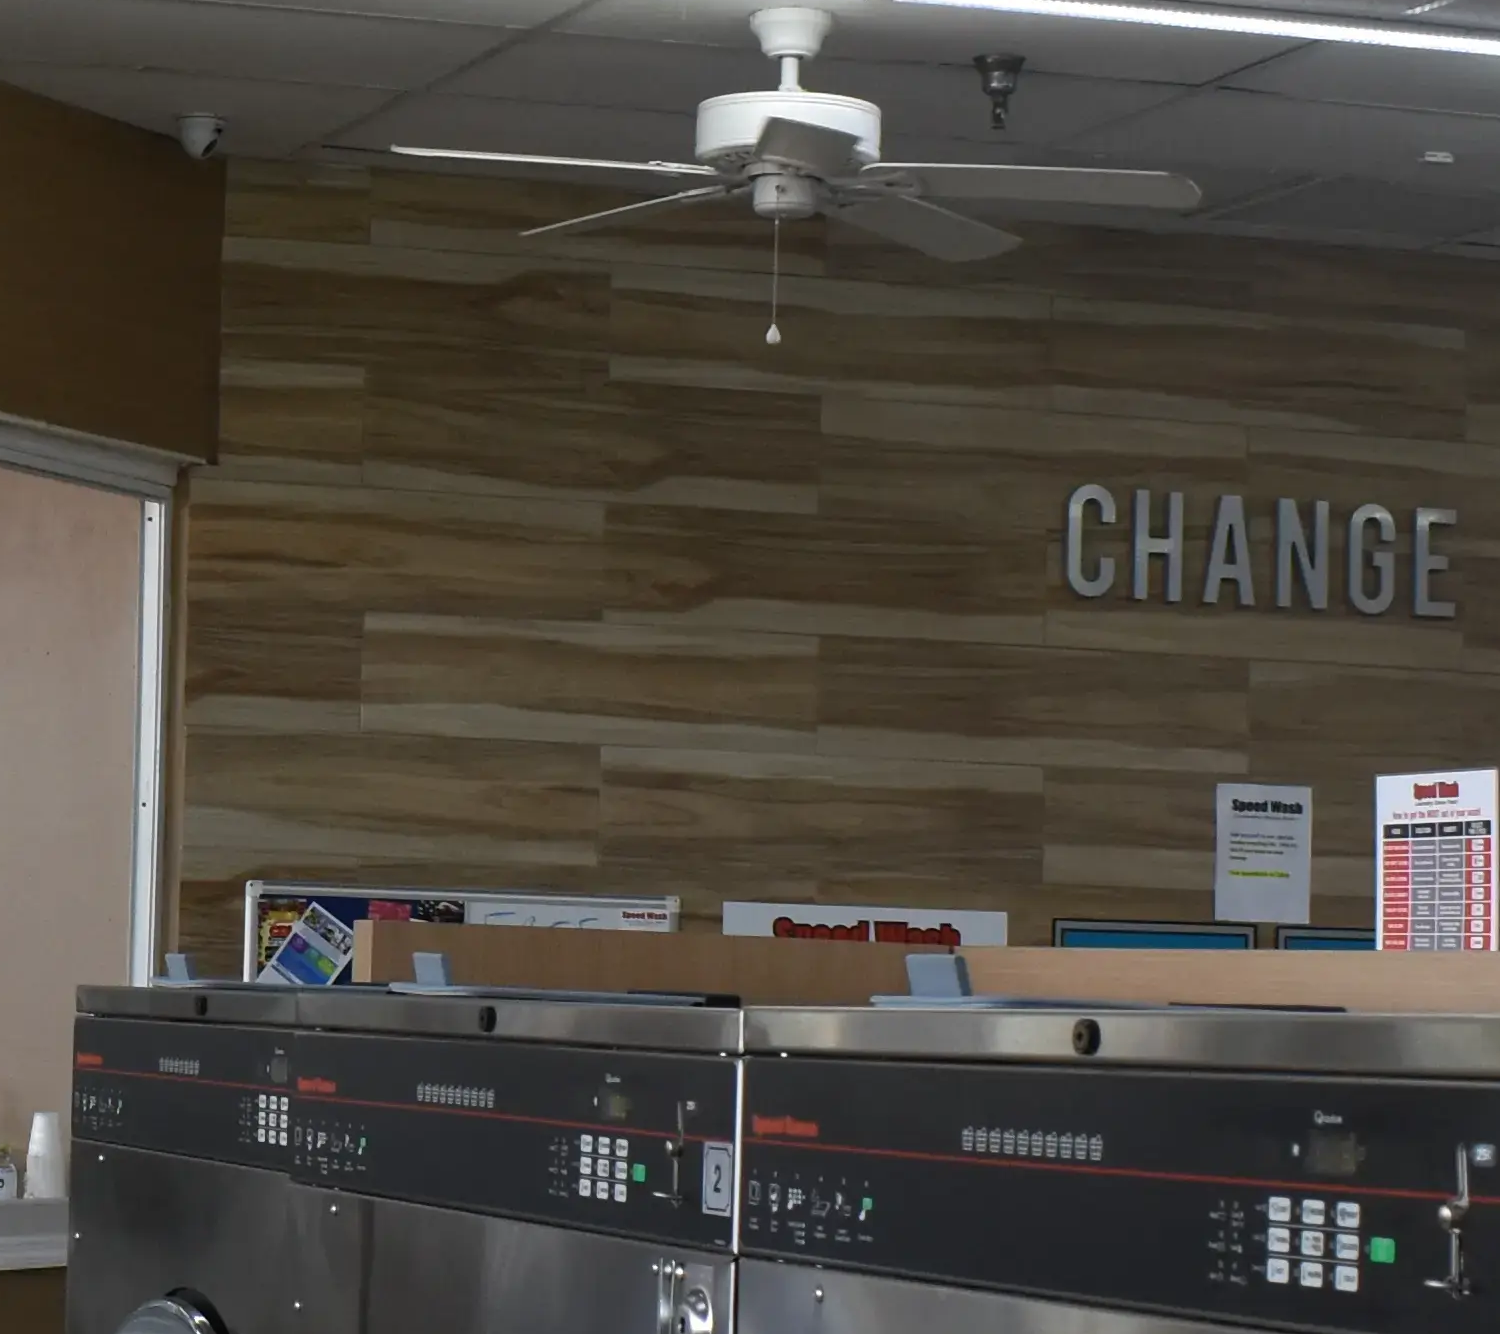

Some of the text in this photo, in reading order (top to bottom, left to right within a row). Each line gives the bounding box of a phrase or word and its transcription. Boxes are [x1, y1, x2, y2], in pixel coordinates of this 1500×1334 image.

[1065, 483, 1458, 618] CHANGE
[1232, 799, 1303, 814] Speed Wash
[713, 1164, 722, 1193] 2
